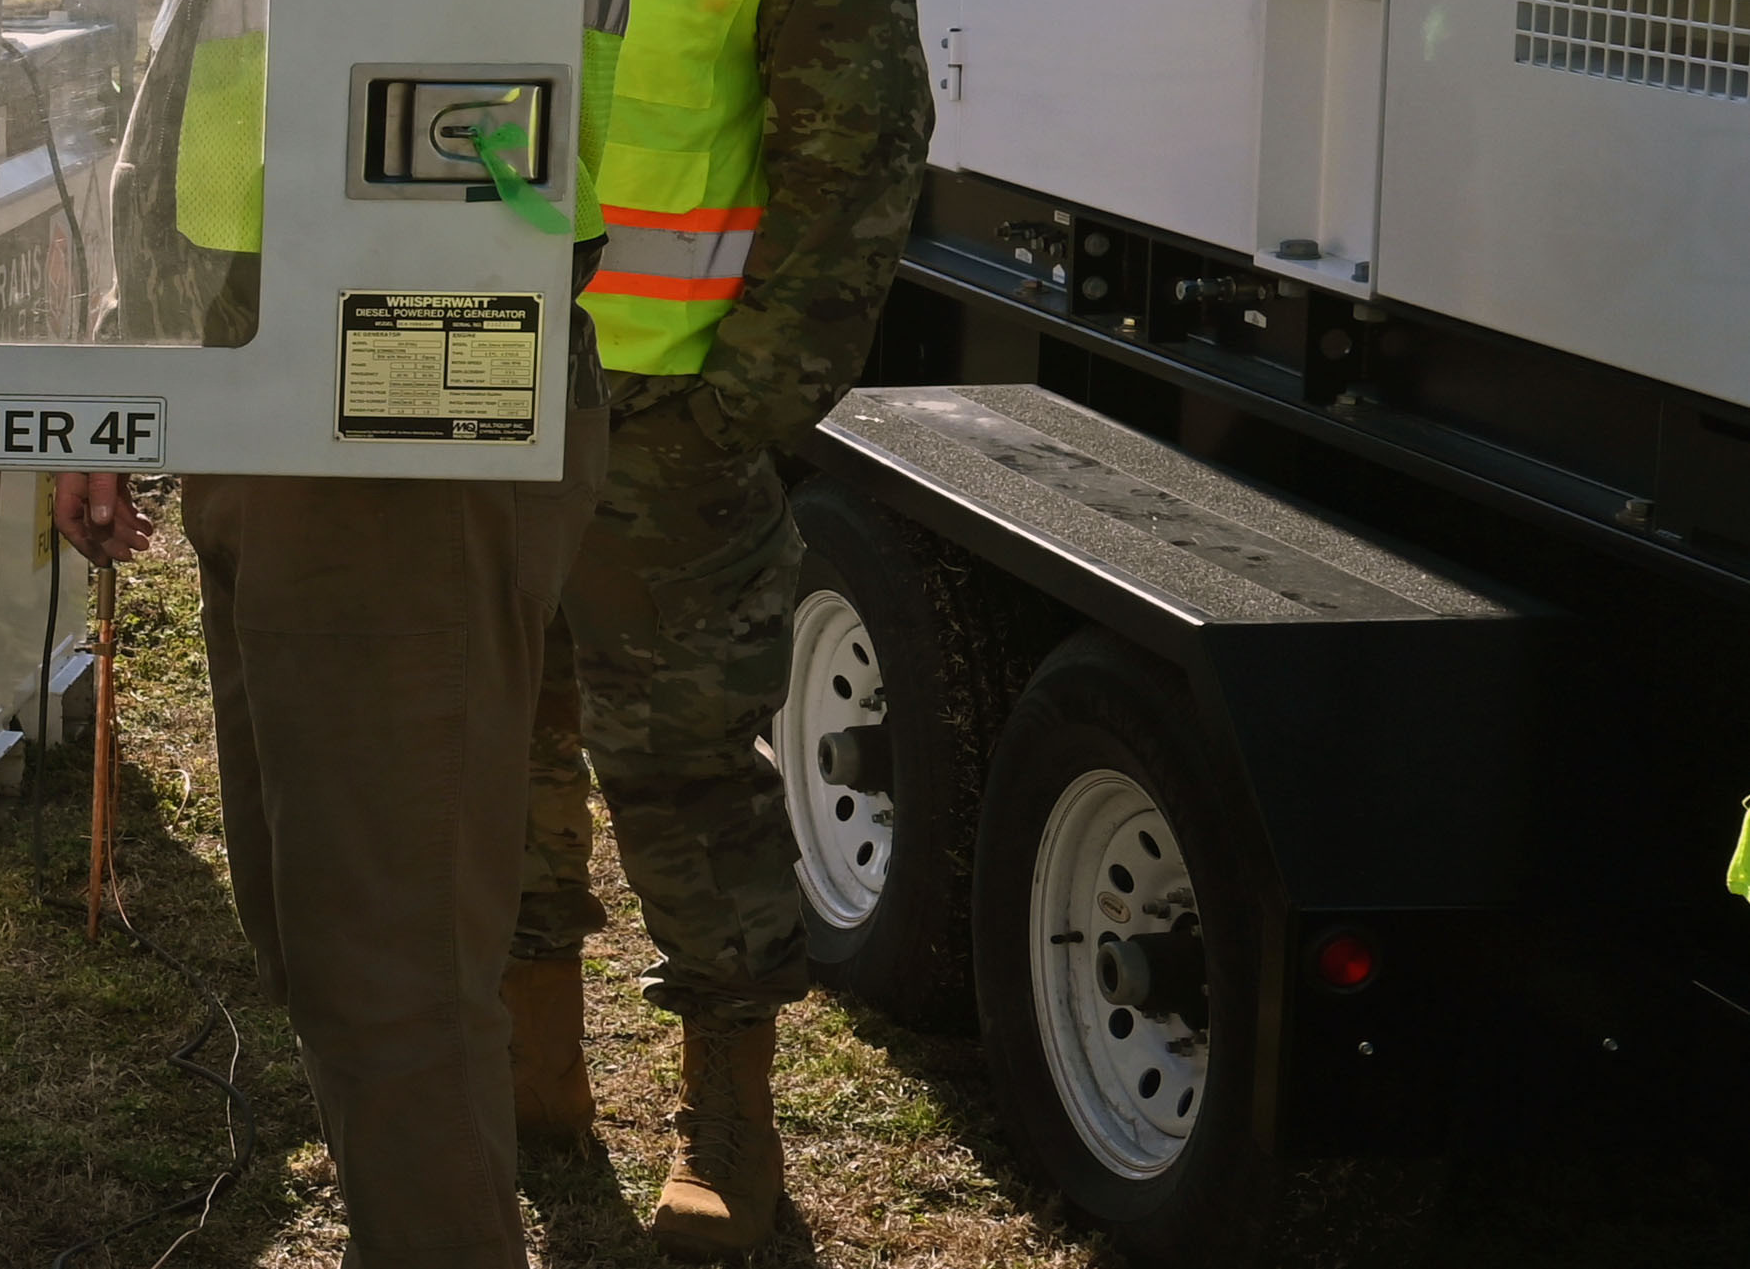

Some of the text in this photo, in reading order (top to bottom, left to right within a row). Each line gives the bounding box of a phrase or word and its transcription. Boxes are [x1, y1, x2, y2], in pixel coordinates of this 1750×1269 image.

[386, 296, 489, 308] WHISPERWATT
[355, 308, 526, 319] DIESEL POWERED AC GENERATOR
[90, 411, 156, 454] 4F
